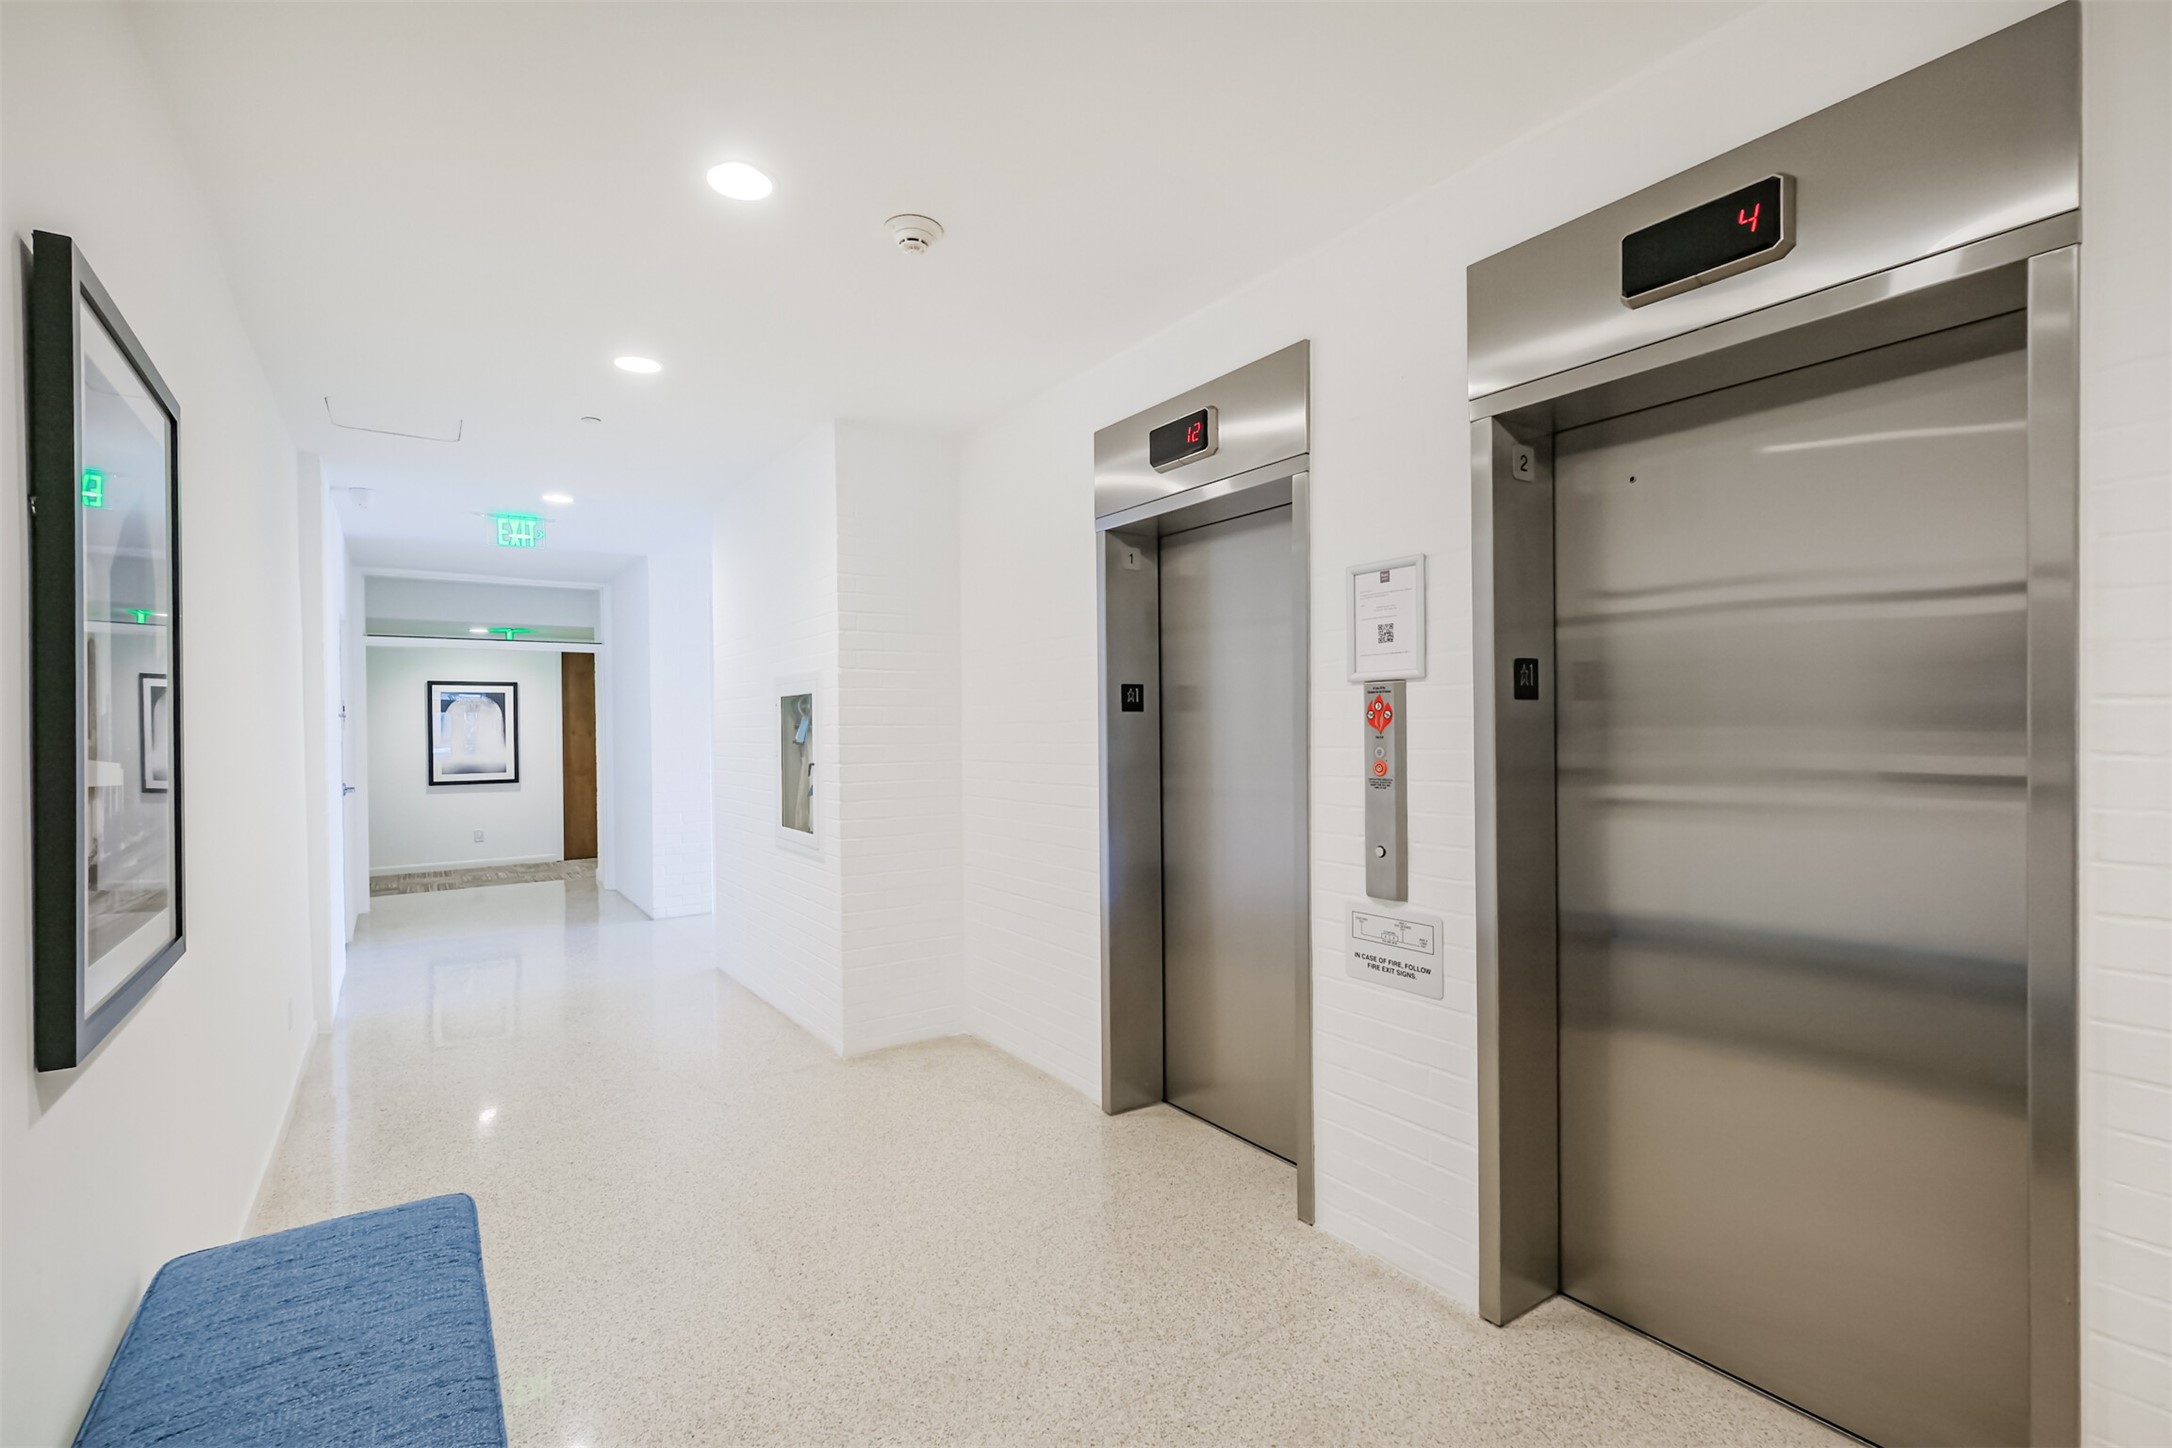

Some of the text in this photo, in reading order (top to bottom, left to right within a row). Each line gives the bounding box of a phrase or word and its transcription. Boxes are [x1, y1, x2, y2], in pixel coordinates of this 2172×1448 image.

[1738, 203, 1760, 233] 4
[1186, 421, 1202, 443] 12
[1520, 454, 1528, 472] 2
[497, 518, 537, 547] EXIT
[1129, 553, 1134, 565] 1
[1361, 953, 1378, 963] CASE
[1378, 957, 1387, 965] OF
[1388, 959, 1404, 969] FIRE,
[1404, 963, 1432, 975] FOLLOW
[1367, 962, 1418, 980] FIRE EXIT SIGNS.
